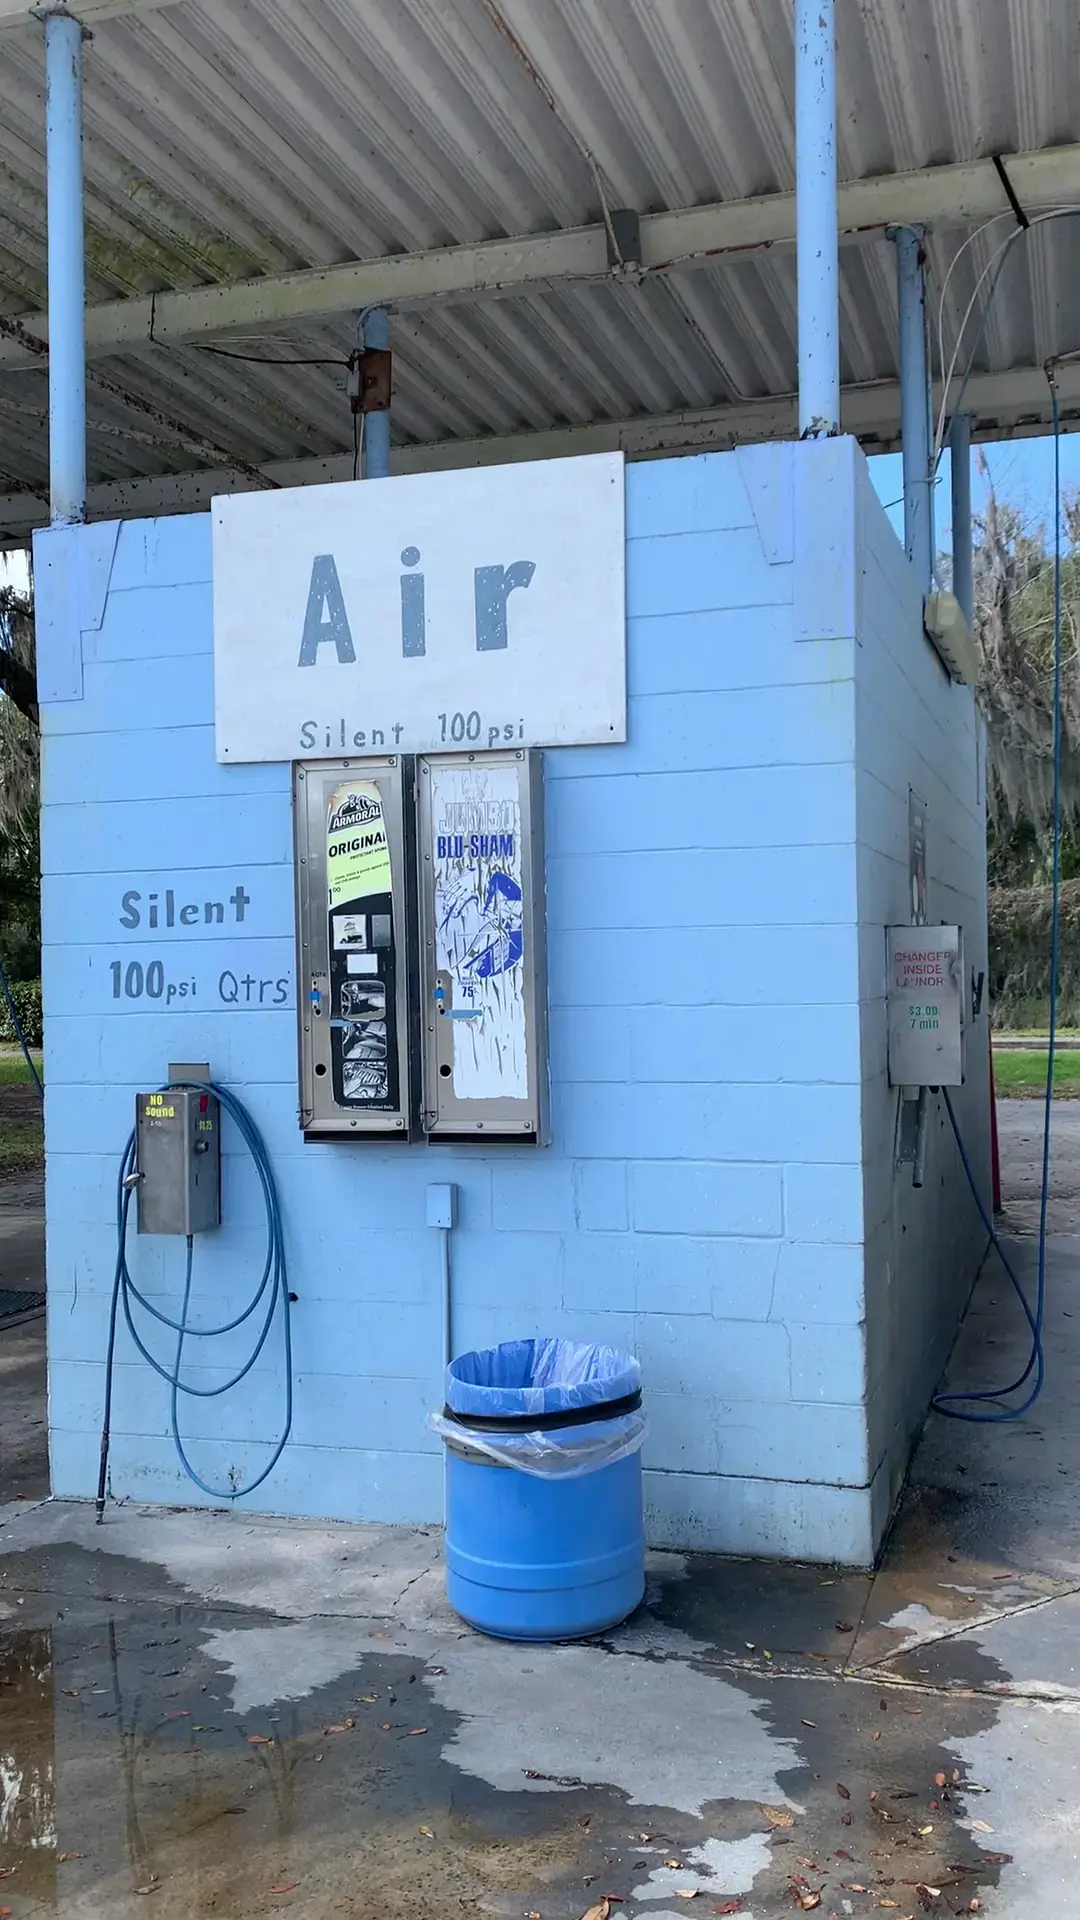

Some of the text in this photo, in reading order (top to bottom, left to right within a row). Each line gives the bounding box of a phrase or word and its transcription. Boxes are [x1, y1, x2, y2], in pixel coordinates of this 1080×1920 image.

[298, 545, 537, 668] Air
[300, 718, 404, 749] Silent
[437, 834, 513, 859] BLU-SHAM
[119, 886, 251, 930] Silent
[903, 964, 943, 975] INSIDE
[218, 970, 290, 1004] Qtrs
[908, 1005, 938, 1017] $3.00
[910, 1018, 939, 1029] 7 min
